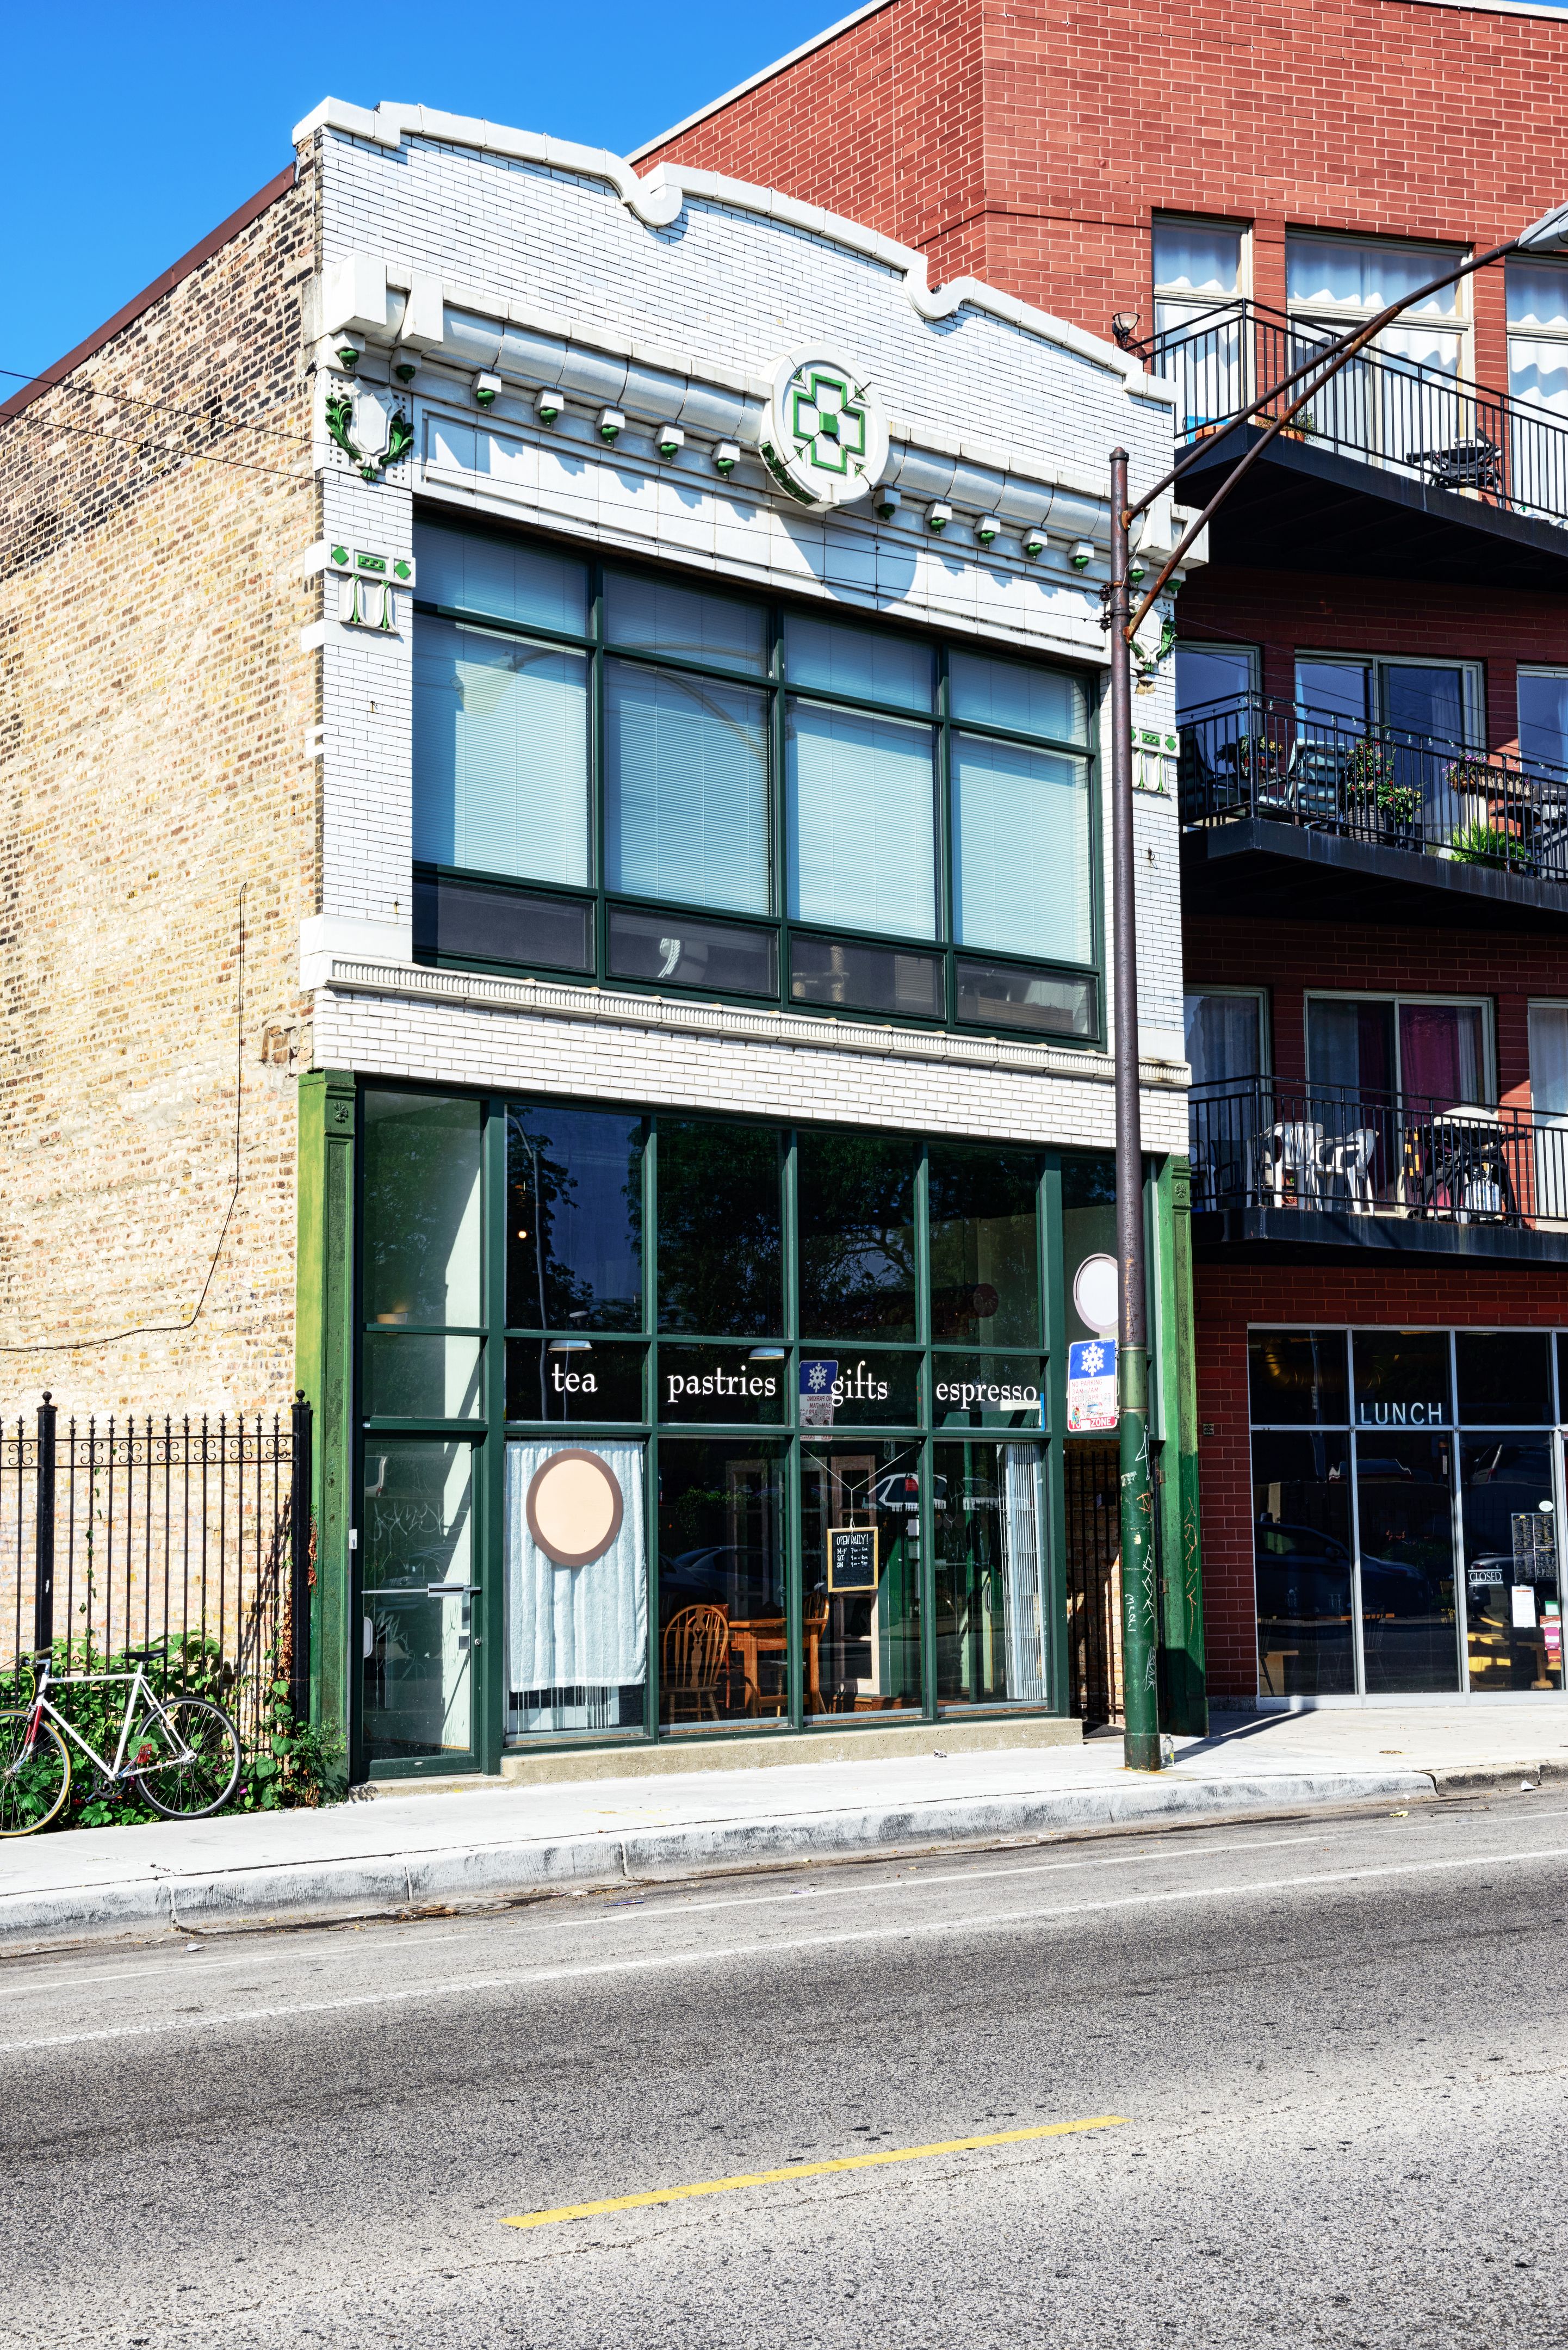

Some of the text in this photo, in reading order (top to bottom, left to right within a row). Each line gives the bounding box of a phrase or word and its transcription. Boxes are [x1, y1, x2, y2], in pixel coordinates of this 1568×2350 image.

[551, 1363, 598, 1393] tea
[667, 1365, 776, 1403] pastries
[831, 1360, 888, 1407] gifts
[936, 1383, 1037, 1409] espresso
[1090, 1417, 1112, 1427] ZONE
[1361, 1402, 1442, 1425] LUNCH
[836, 1533, 868, 1545] OPEN DAILY!
[1470, 1572, 1502, 1582] CLOSED
